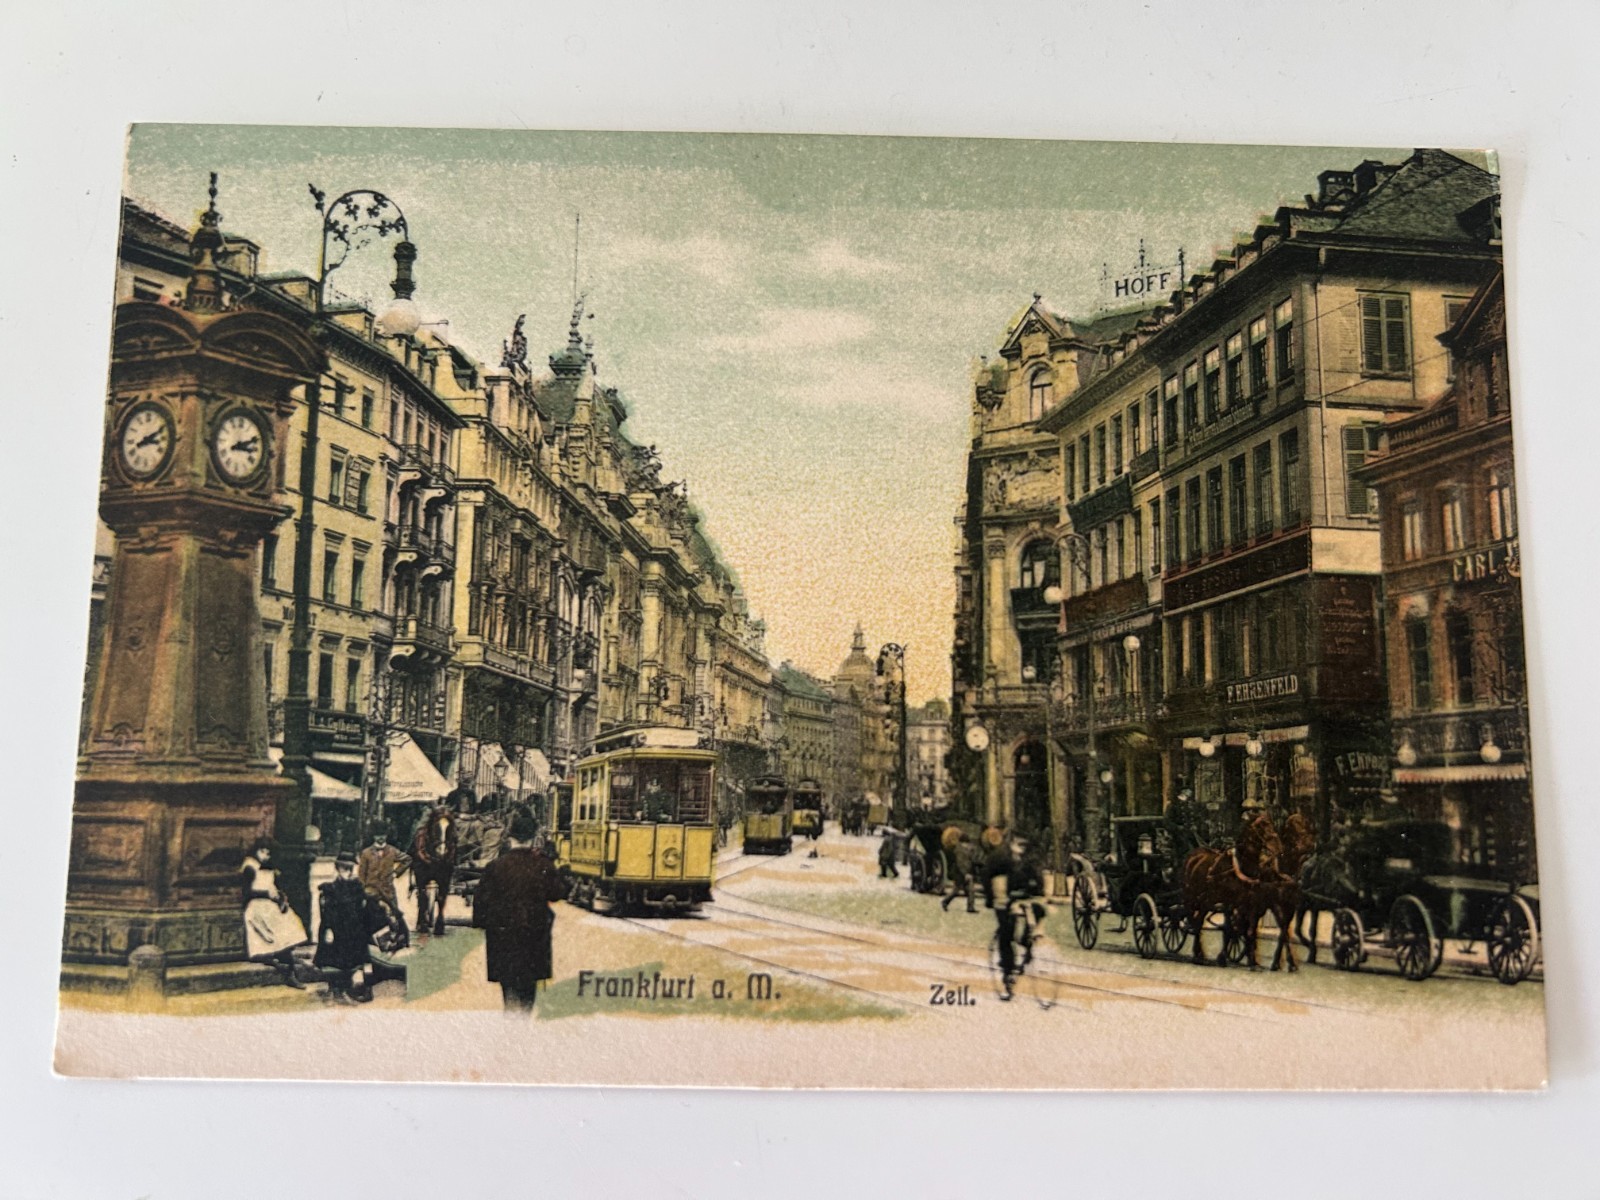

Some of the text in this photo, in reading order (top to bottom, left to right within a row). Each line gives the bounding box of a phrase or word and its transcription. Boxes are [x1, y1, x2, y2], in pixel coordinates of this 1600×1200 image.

[1114, 272, 1171, 298] HOFF
[1235, 674, 1298, 702] EHRENFELD
[577, 970, 782, 1000] Frankfurt a. M.
